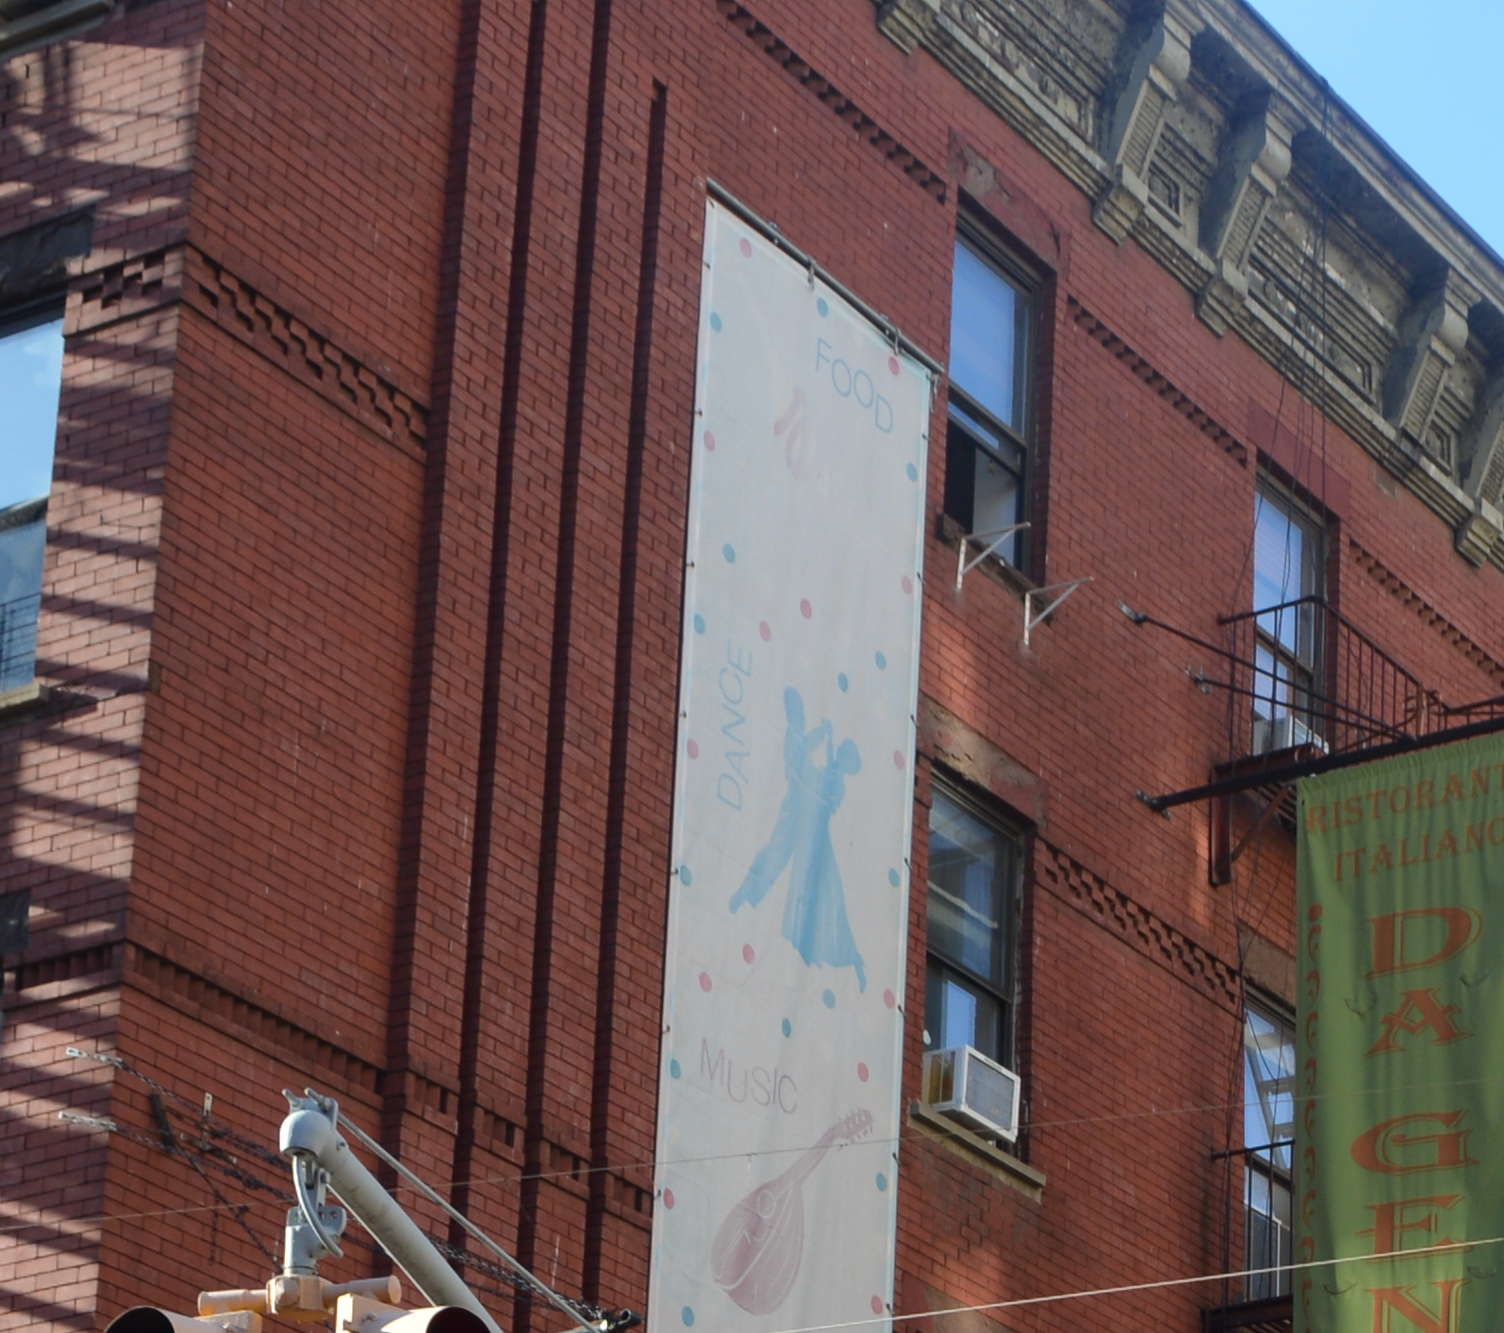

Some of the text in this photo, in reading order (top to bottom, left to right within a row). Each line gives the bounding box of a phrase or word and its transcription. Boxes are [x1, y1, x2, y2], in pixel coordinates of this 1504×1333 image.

[815, 337, 893, 434] FOOD
[717, 638, 753, 812] DANCE
[1361, 904, 1483, 1058] DA
[699, 1036, 798, 1116] MUSIC
